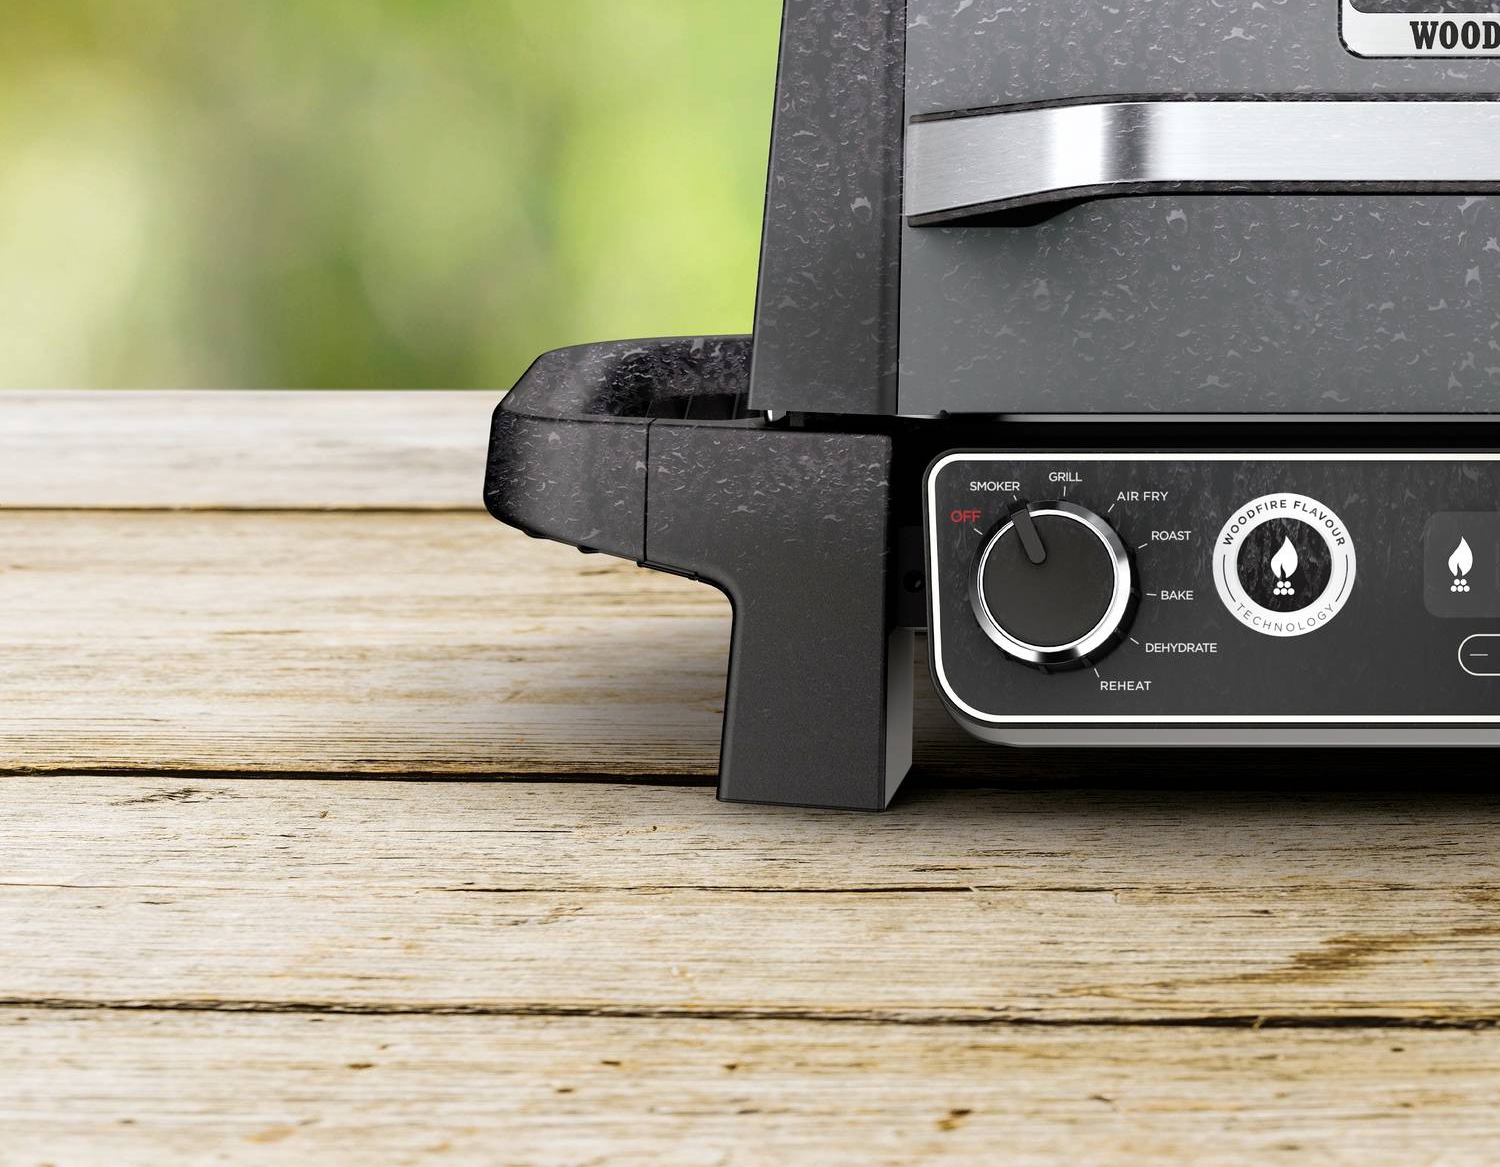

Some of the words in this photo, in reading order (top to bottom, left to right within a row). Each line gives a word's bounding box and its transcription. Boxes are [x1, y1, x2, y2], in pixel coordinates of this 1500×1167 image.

[1048, 471, 1083, 483] GRILL
[969, 480, 1020, 492] SMOKER
[1117, 490, 1139, 502] AIR
[1144, 490, 1169, 502] FRY
[950, 510, 981, 524] OFF
[1222, 500, 1288, 547] WOODFIRE
[1294, 500, 1345, 546] FLAVOUR
[1151, 530, 1191, 542] ROAST
[1161, 590, 1194, 601] BAKE
[1235, 602, 1335, 632] TECHNOLOGY
[1145, 642, 1217, 654] DEHYDRATE
[1100, 680, 1152, 692] REHEAT
